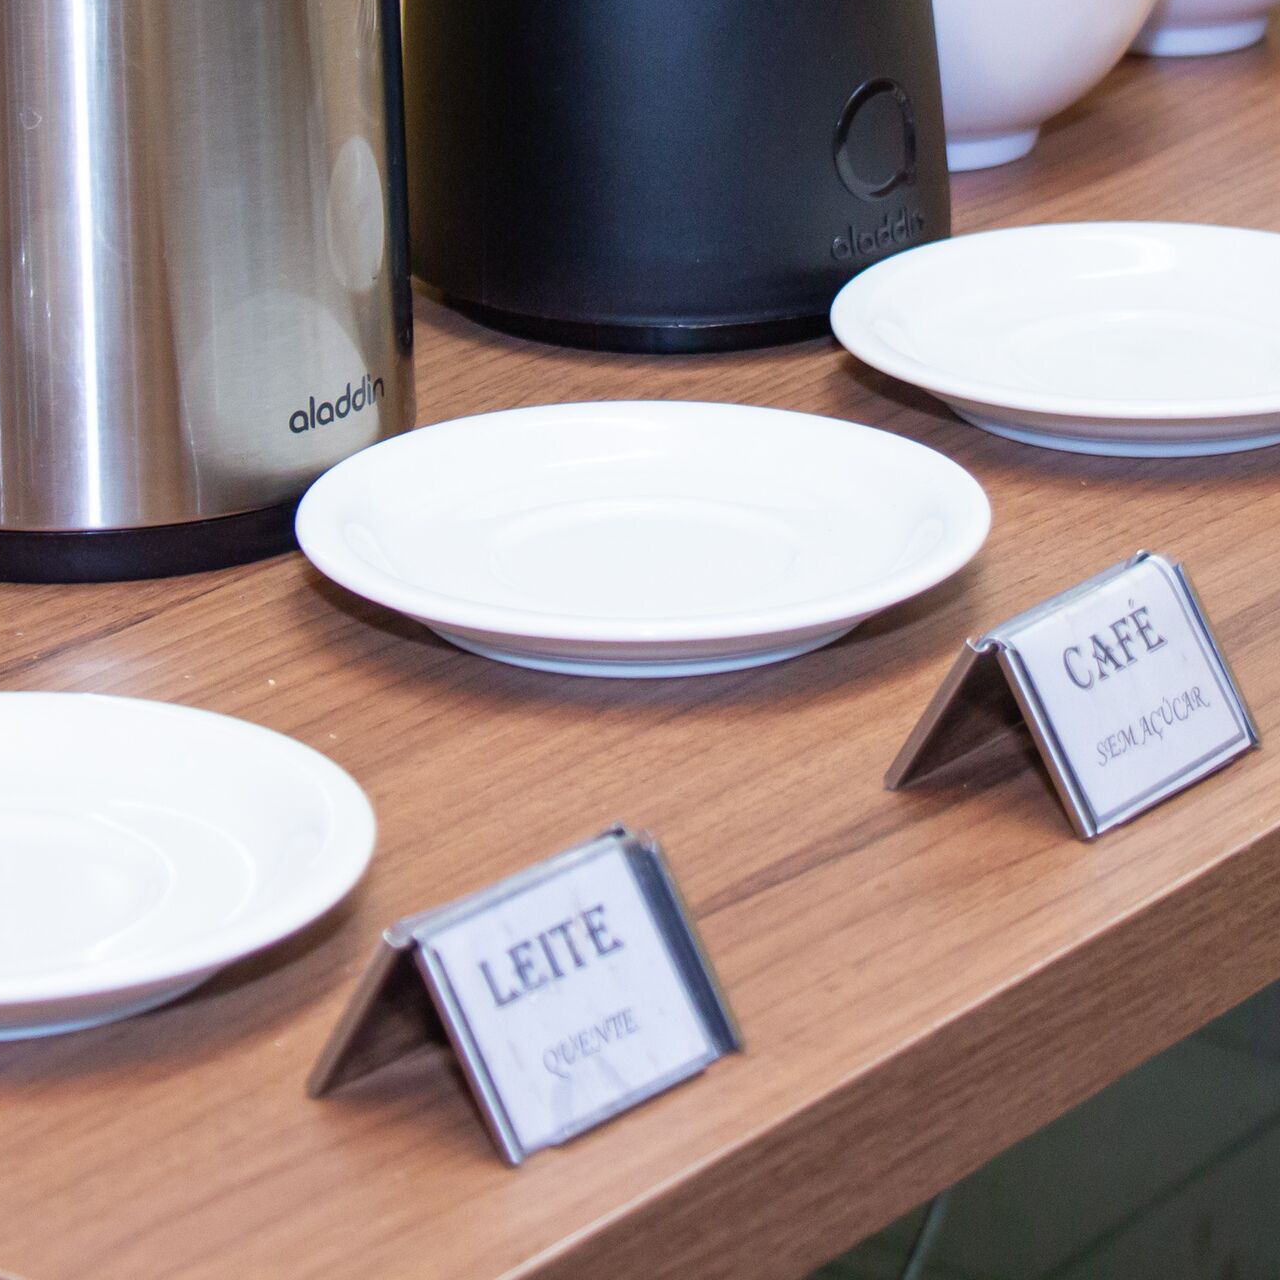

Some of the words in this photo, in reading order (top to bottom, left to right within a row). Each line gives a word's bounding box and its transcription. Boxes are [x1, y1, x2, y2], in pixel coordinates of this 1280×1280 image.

[830, 207, 926, 261] aladdin
[288, 373, 385, 434] aladdin
[1062, 598, 1169, 692] CAFÉ
[1096, 724, 1141, 767] SEM
[1138, 686, 1210, 743] AÇÚCAR
[477, 903, 626, 1010] LEITE
[541, 1006, 641, 1080] QUENTE
